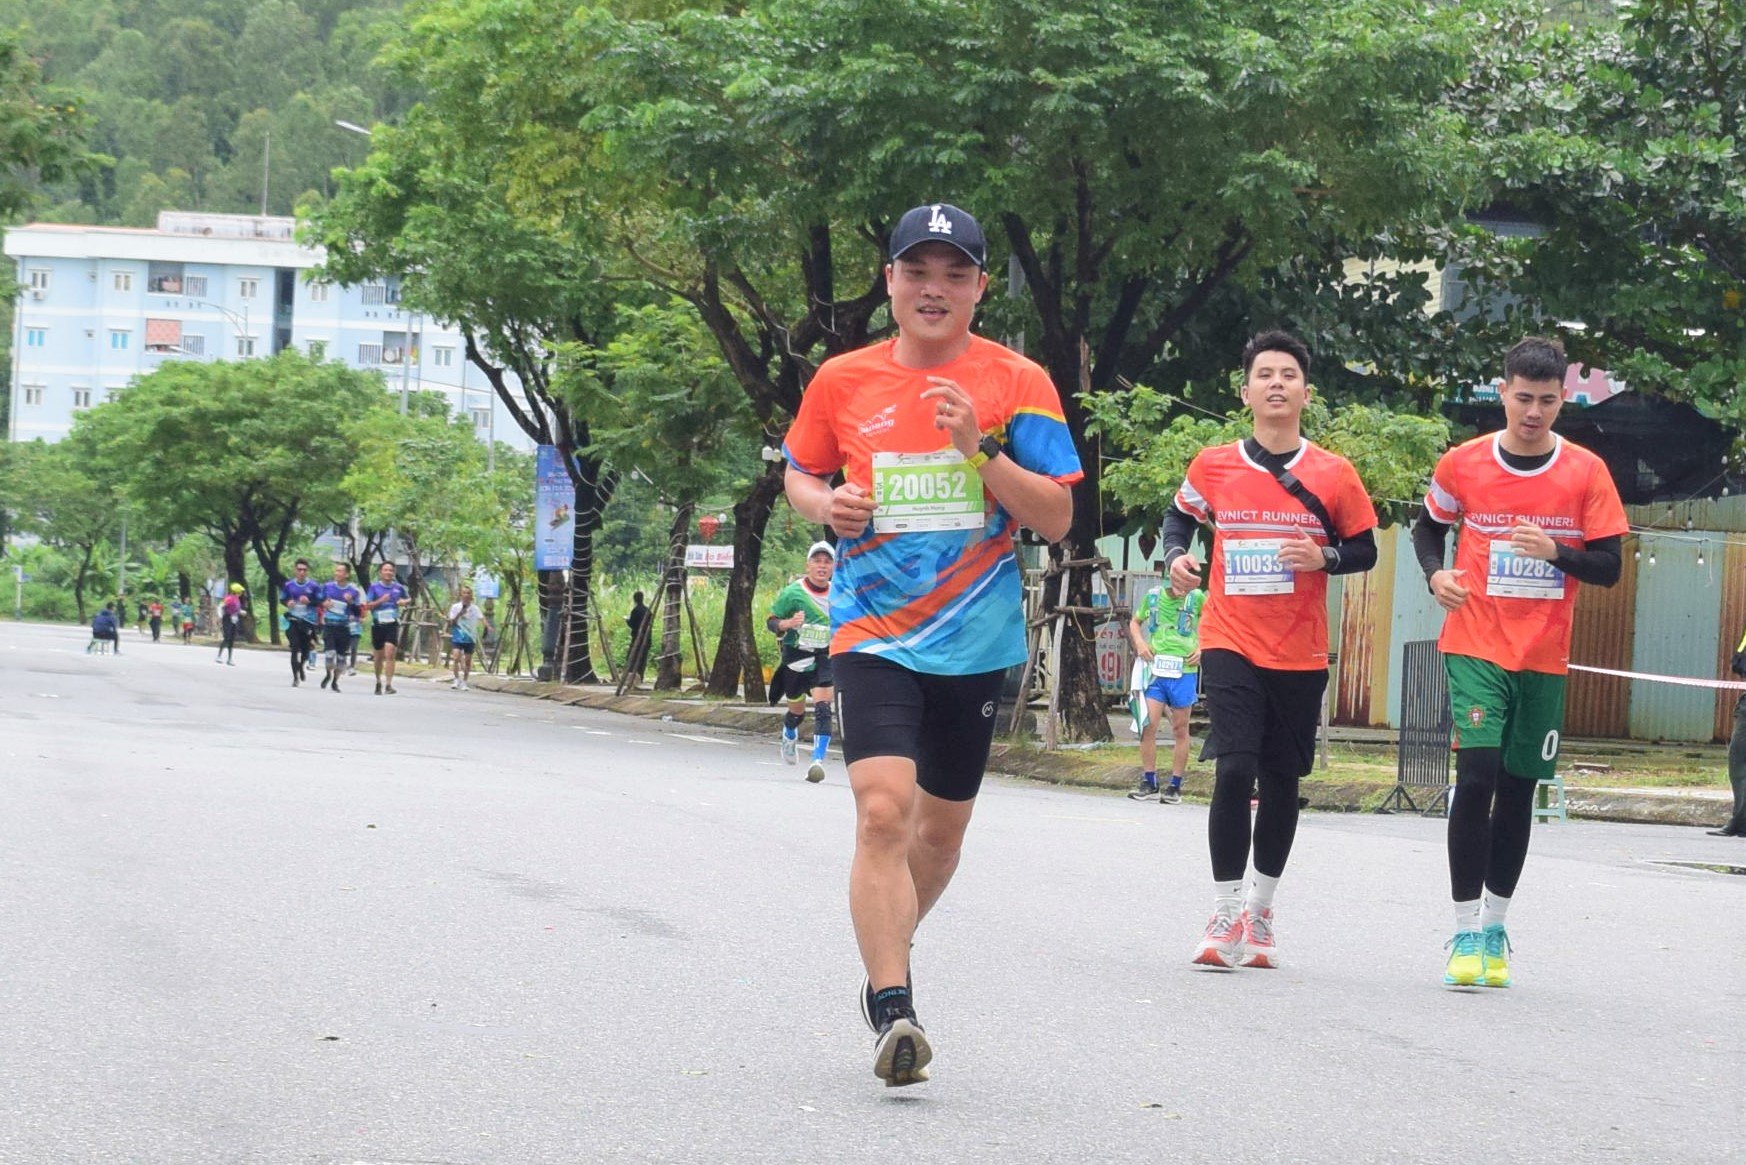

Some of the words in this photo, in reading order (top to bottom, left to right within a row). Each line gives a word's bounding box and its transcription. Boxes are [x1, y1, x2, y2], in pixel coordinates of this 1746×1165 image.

[928, 205, 953, 235] LA
[888, 471, 967, 501] 20052
[1234, 553, 1284, 574] 10033
[1502, 556, 1555, 578] 10282
[1541, 729, 1559, 762] 0
